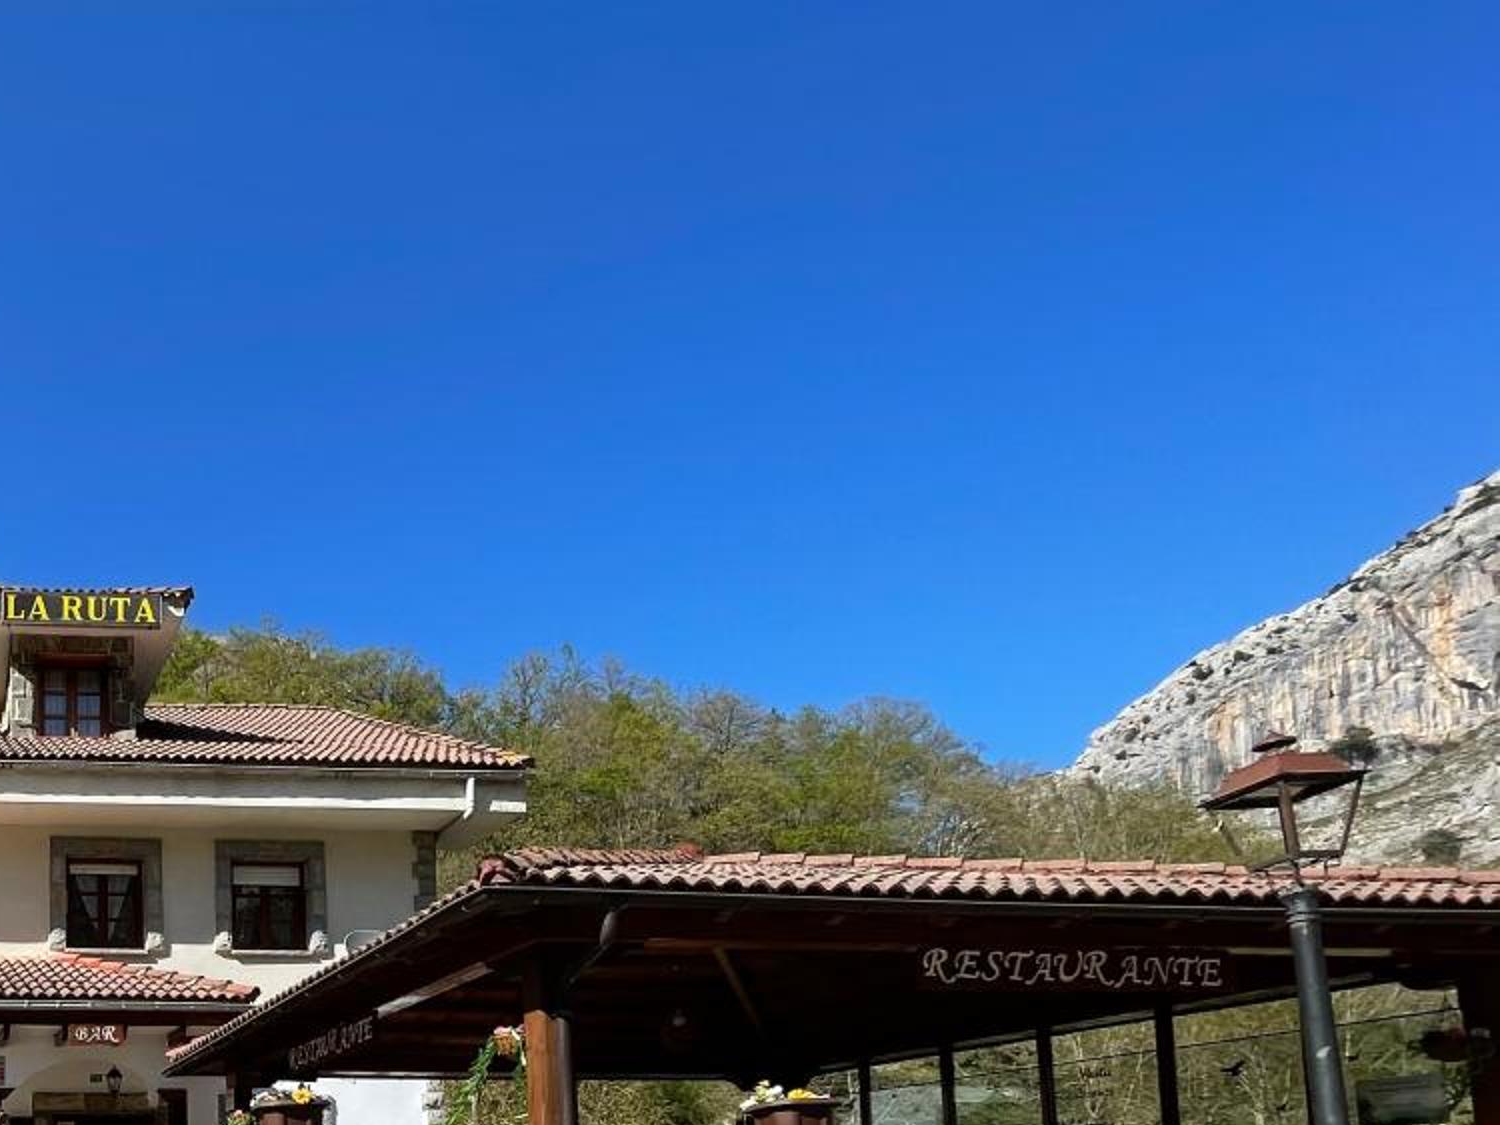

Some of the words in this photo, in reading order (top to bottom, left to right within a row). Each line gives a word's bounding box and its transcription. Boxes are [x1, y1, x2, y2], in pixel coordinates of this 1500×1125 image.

[6, 594, 49, 622] LA
[60, 596, 157, 624] RUTA
[922, 947, 1224, 988] RESTAURANTE
[75, 1025, 120, 1043] BAR
[289, 1015, 373, 1071] RESTAURANTE
